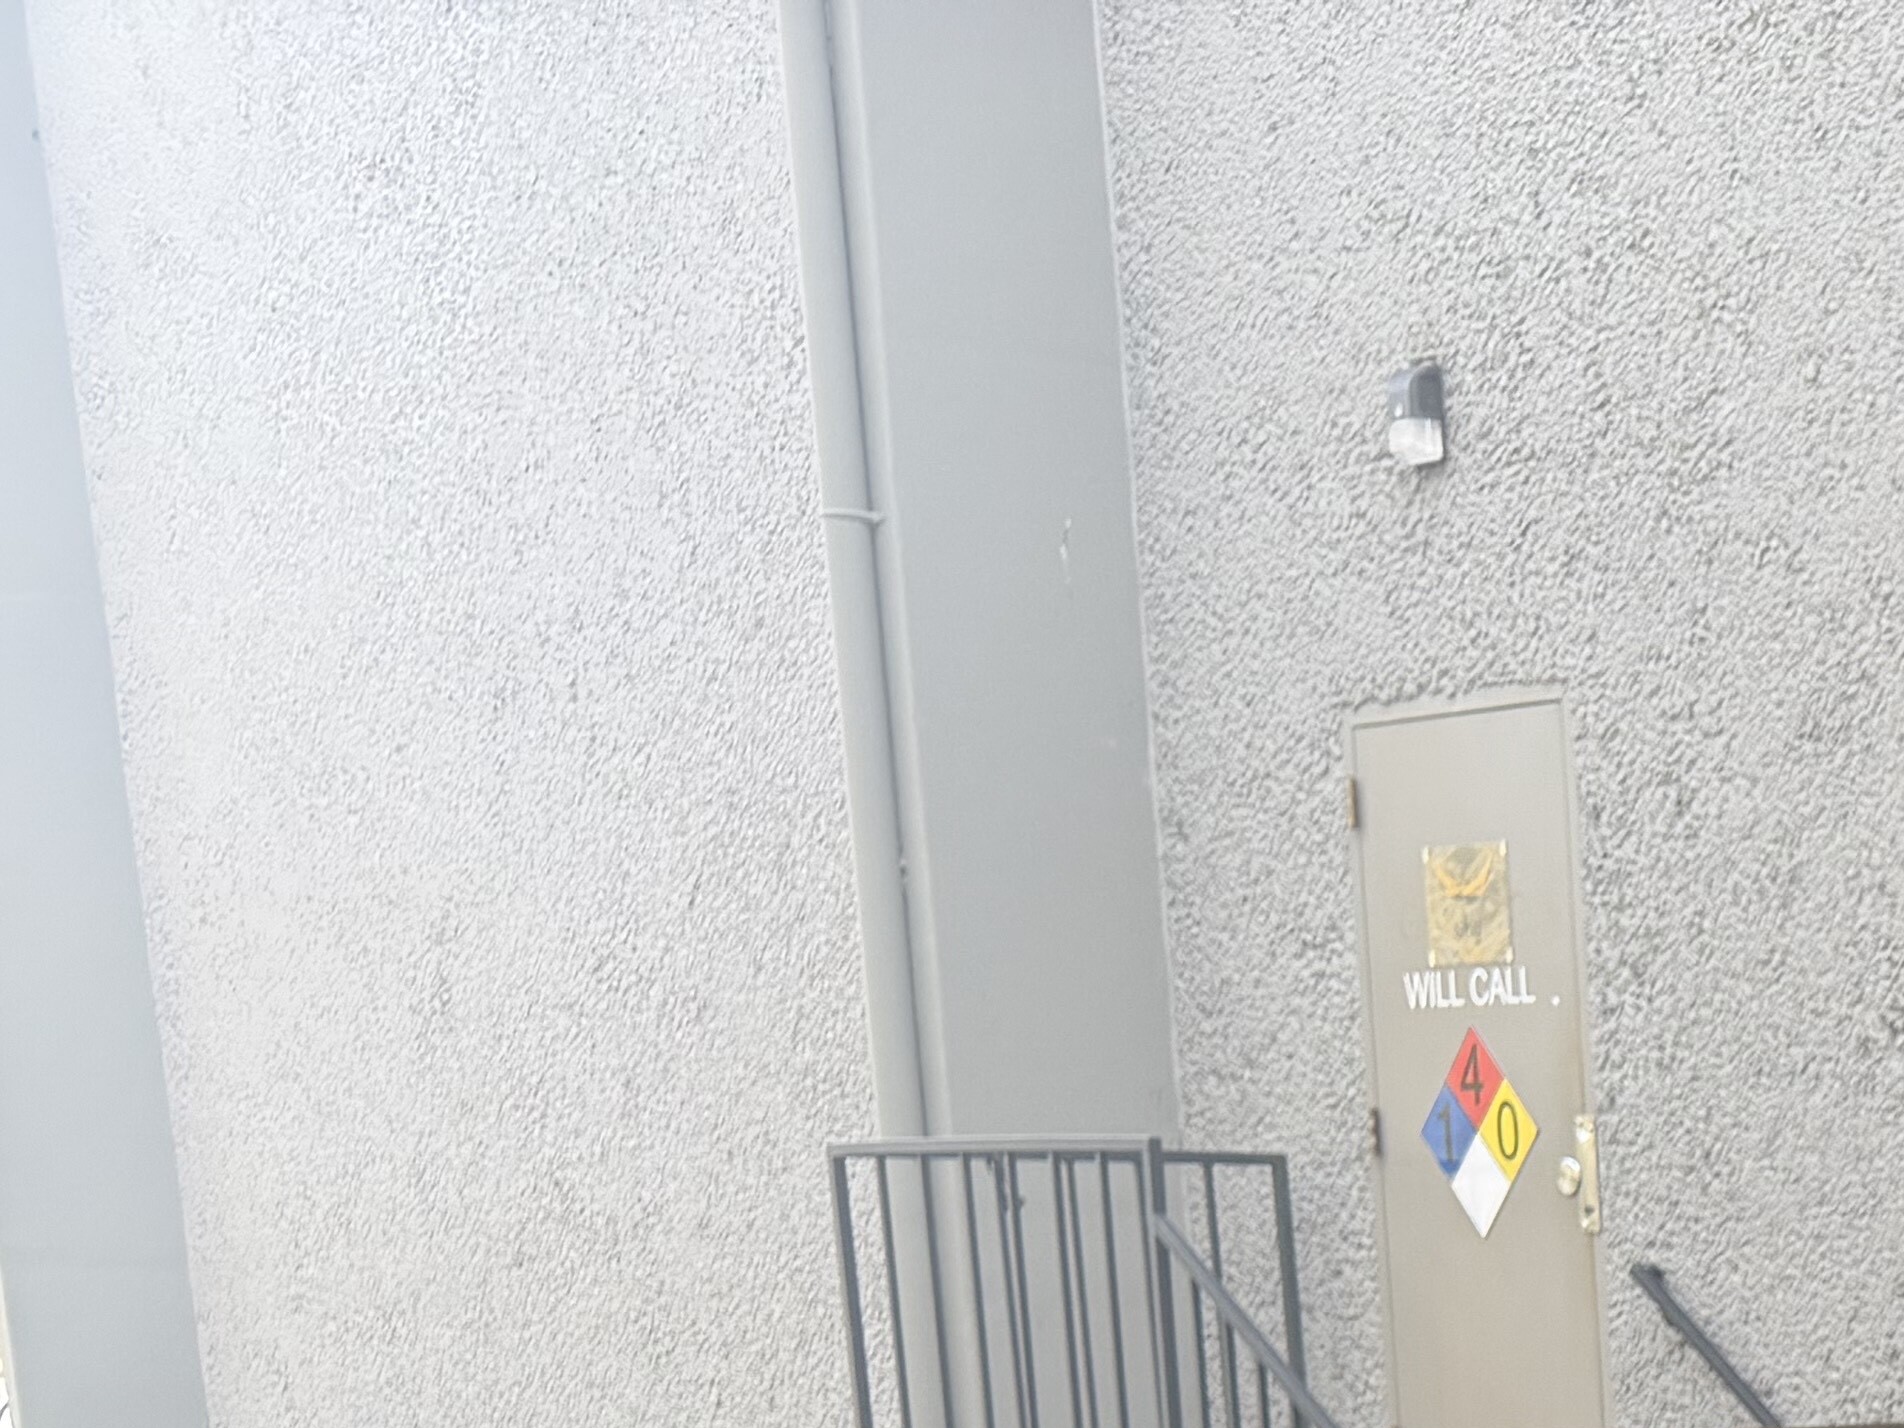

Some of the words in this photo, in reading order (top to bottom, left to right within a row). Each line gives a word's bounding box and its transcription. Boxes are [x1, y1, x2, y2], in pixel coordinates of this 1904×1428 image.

[1403, 968, 1465, 1010] WILL
[1469, 966, 1536, 1007] CALL
[1460, 1044, 1484, 1105] 4
[1438, 1102, 1454, 1163] 1
[1497, 1101, 1519, 1160] 0
